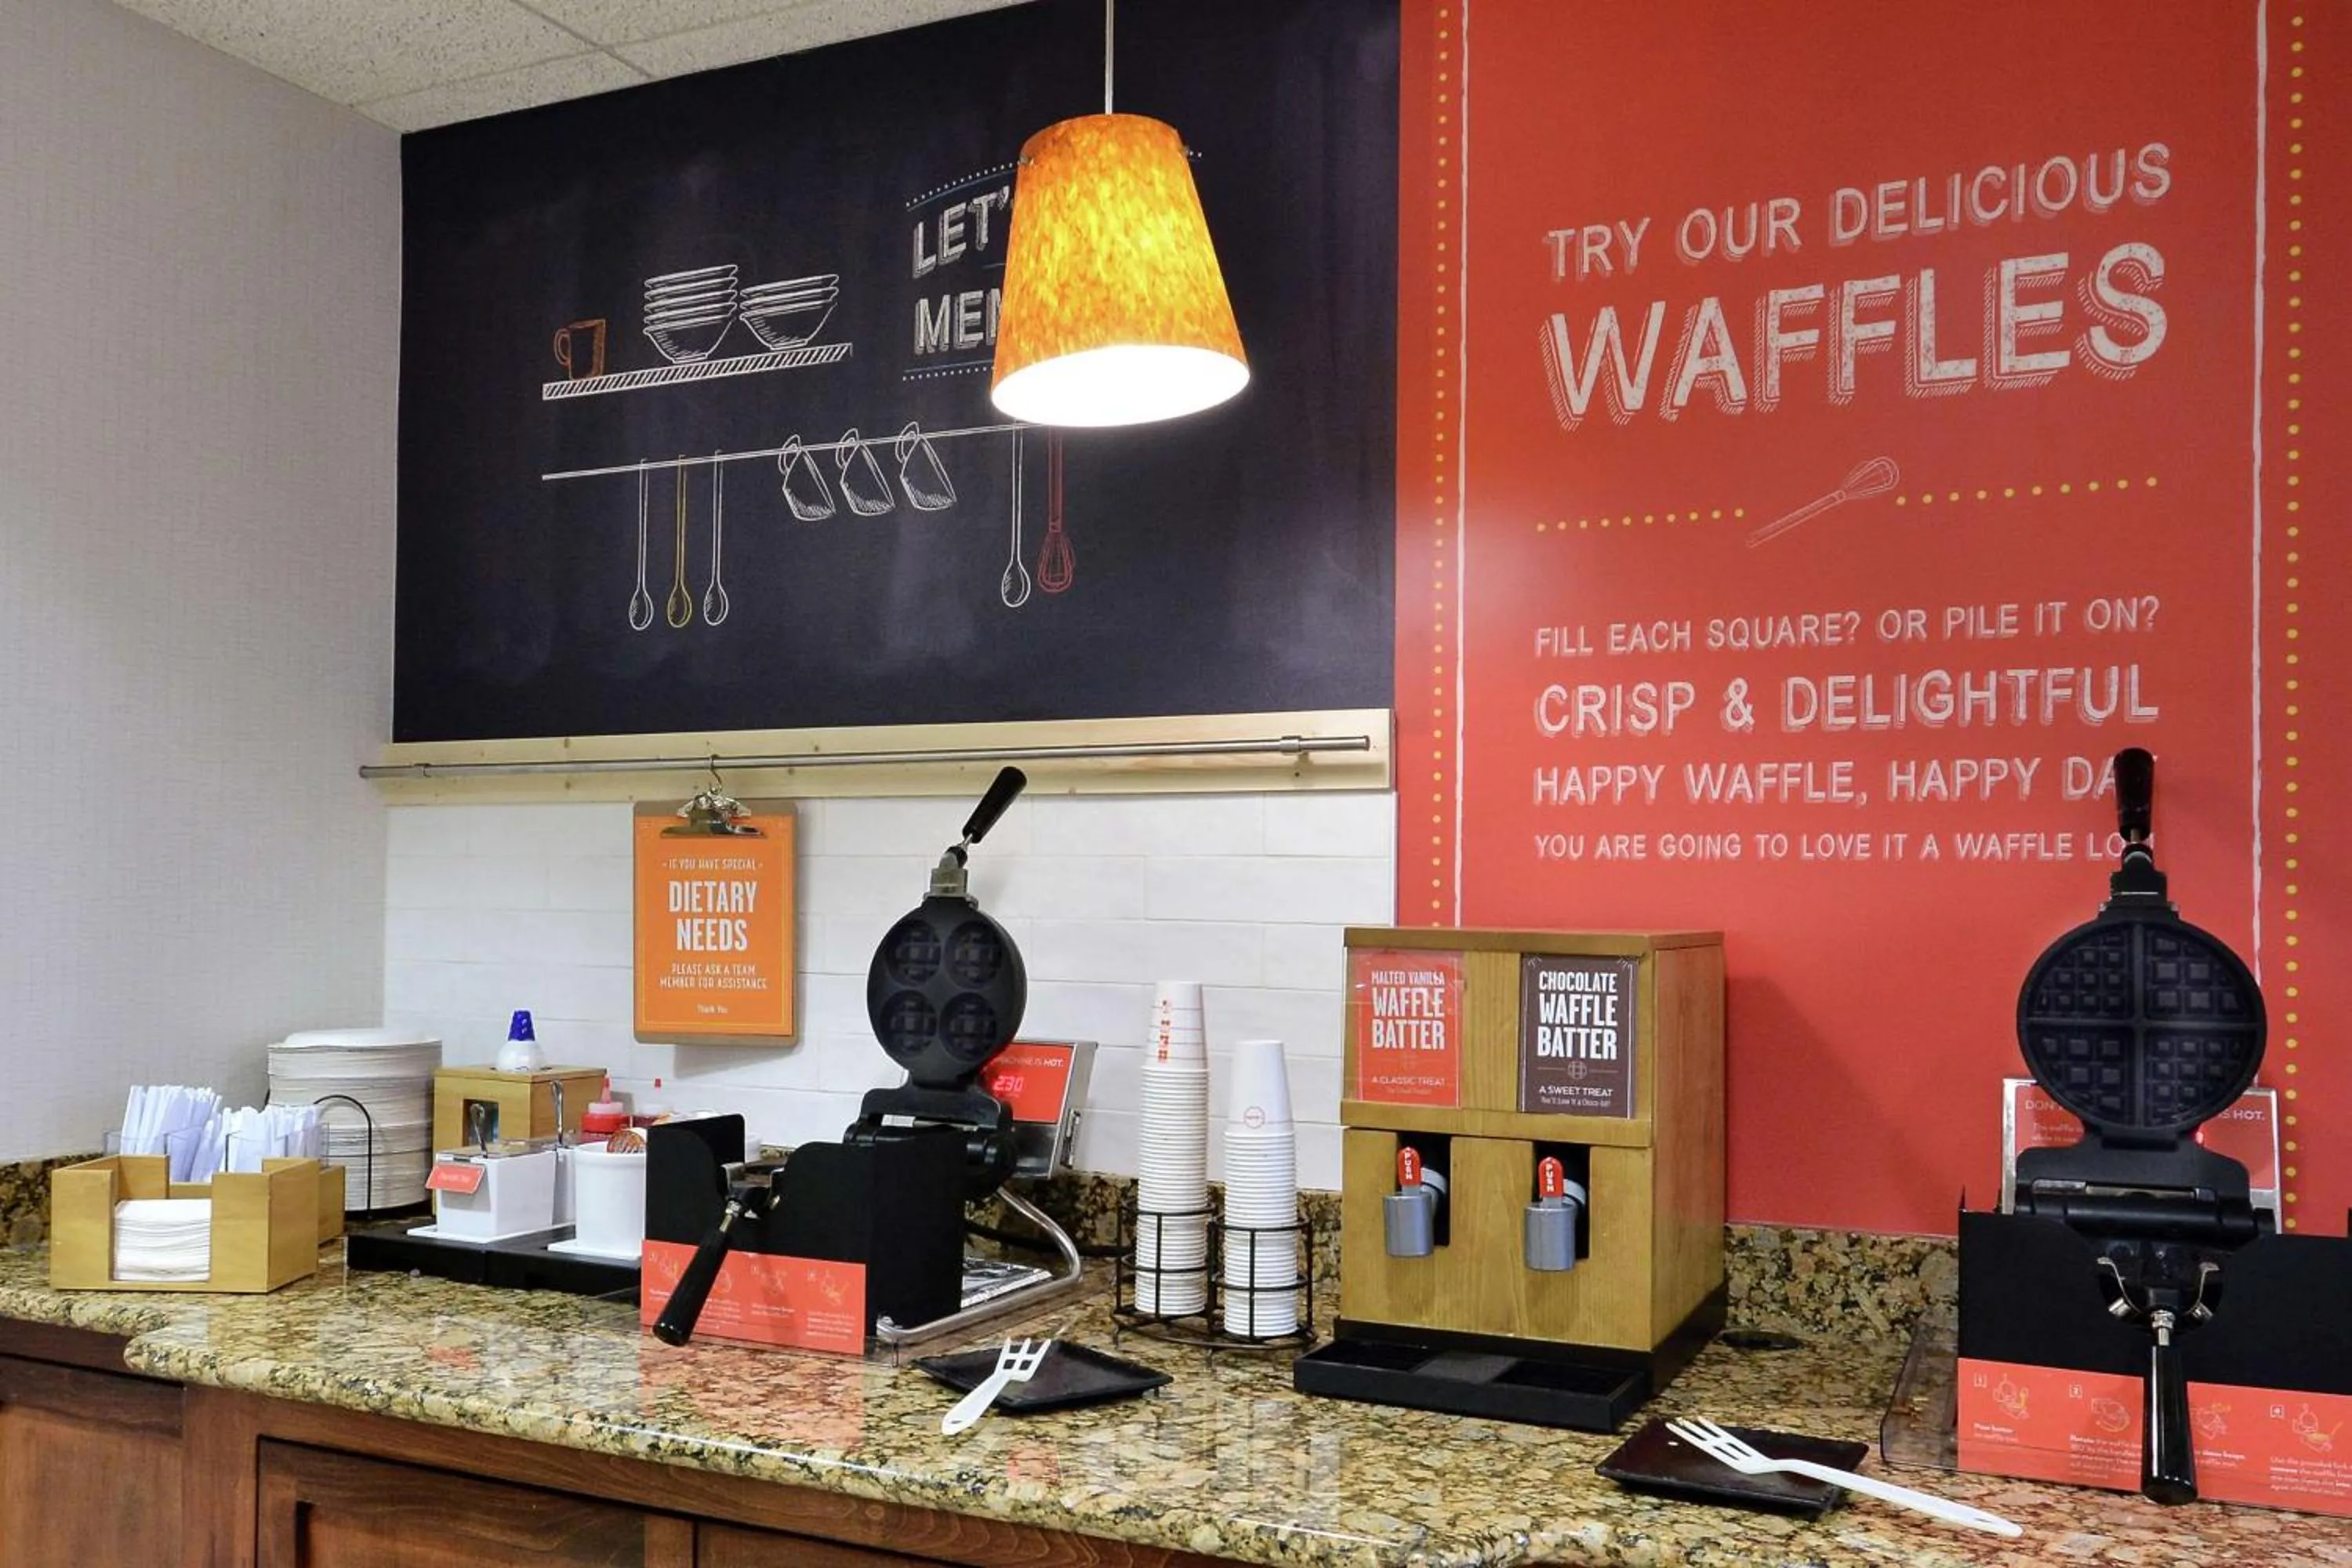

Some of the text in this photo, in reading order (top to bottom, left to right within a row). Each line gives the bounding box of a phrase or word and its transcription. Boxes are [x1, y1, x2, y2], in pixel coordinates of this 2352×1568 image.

[1542, 142, 2171, 282] TRY OUR DELICIOUS
[912, 185, 1014, 278] LET'
[1539, 241, 2167, 431] WAFFLES
[1534, 596, 2160, 657] FILL EACH SQUARE? OR PILE IT ON?
[1534, 663, 2159, 739] CRISP & DELIGHTFUL
[1534, 755, 2158, 806] HAPPY WAFFLE, HAPPY DA
[1534, 833, 1584, 861] YOU
[1595, 833, 1647, 860] ARE
[1657, 833, 1742, 861] GOING
[1754, 833, 1789, 860] TO
[1800, 833, 1872, 861] LOVE
[1882, 833, 1907, 860] IT
[1918, 833, 1940, 861] A
[1954, 832, 2073, 861] WAFFLE
[722, 858, 756, 870] SPECIAL
[669, 880, 757, 913] DIETARY
[677, 918, 747, 951] NEEDS
[659, 976, 768, 989] MEMBER FOR ASSISTANCE
[672, 964, 756, 975] PLEASE ASK A TEAM
[1371, 971, 1406, 985] MALTED
[1539, 971, 1618, 993] CHOCOLATE
[1372, 987, 1445, 1017] WAFFLE
[1539, 993, 1619, 1026] WAFFLE
[1372, 1018, 1445, 1049] BATTER
[1537, 1025, 1617, 1059] BATTER
[993, 1075, 1025, 1092] 230
[1539, 1086, 1614, 1097] A SWEET TREAT
[2233, 1109, 2266, 1120] HOT.
